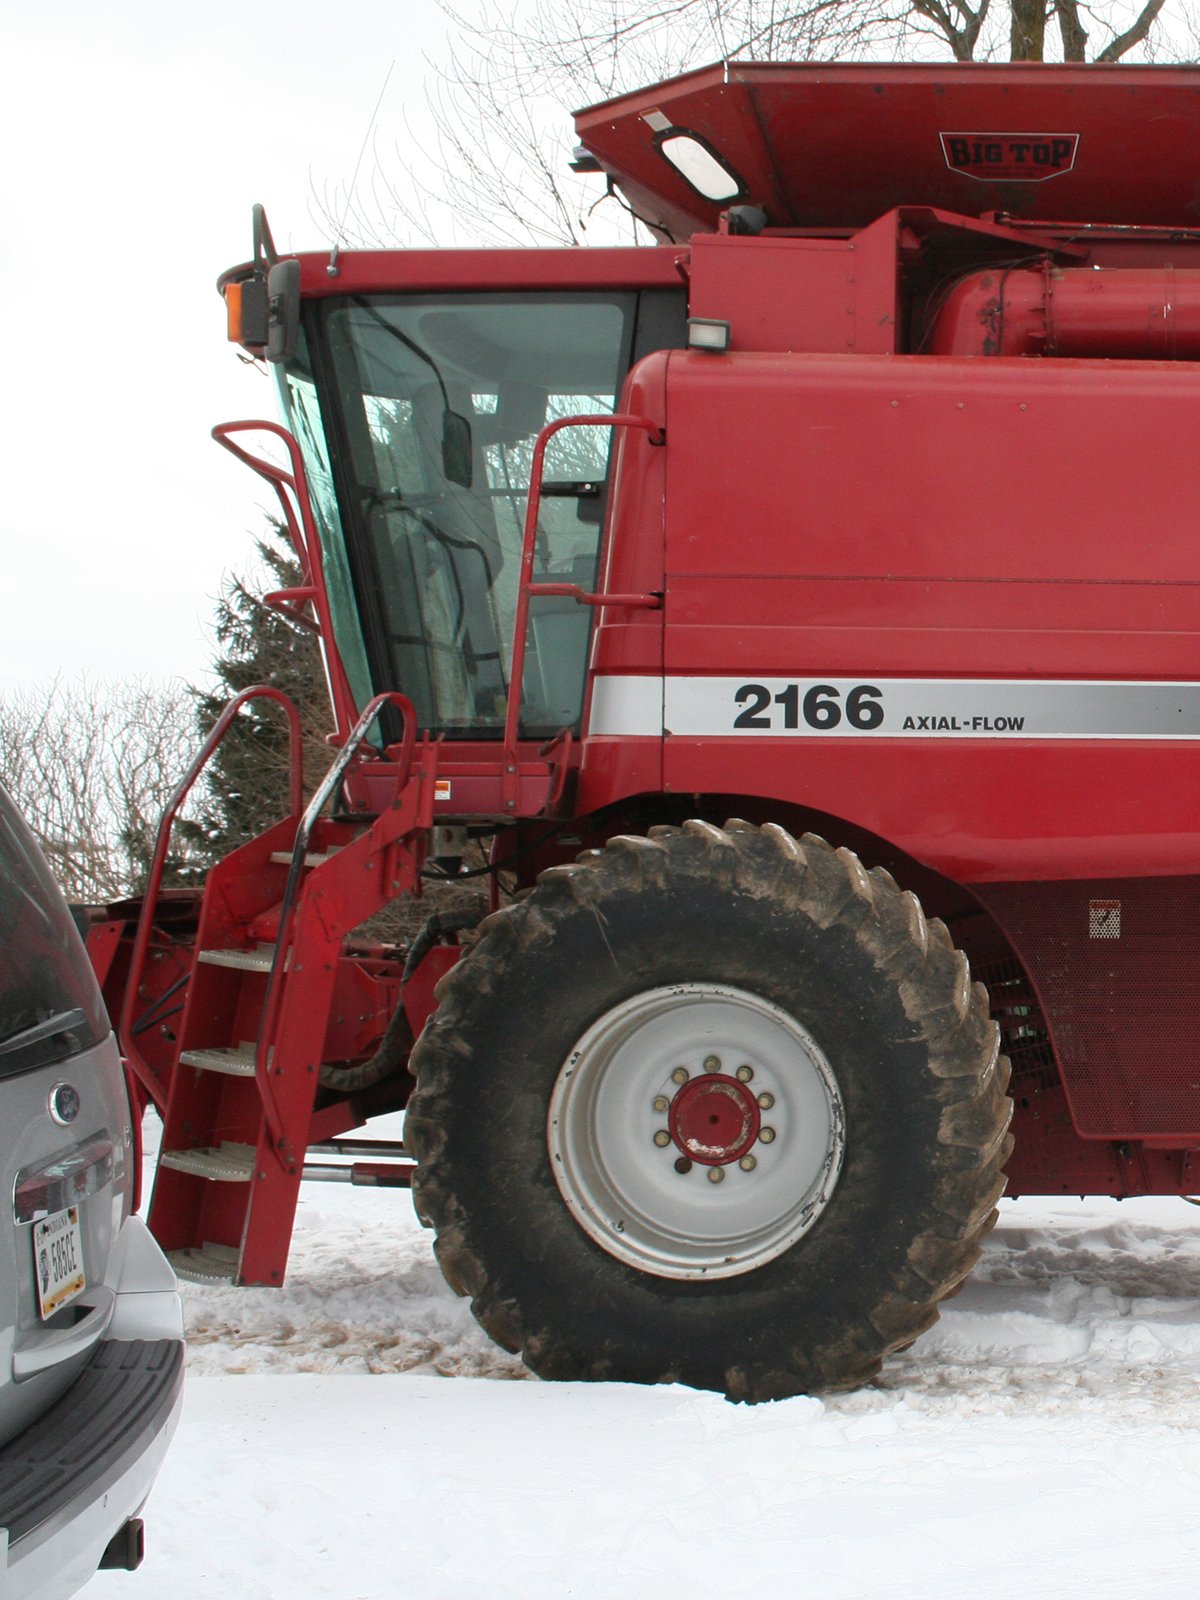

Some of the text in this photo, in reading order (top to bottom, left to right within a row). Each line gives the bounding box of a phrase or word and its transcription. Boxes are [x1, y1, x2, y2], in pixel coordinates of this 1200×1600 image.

[948, 138, 1072, 168] BIG TOP
[733, 684, 1025, 731] 2166 AXIAL-FLOW
[51, 1230, 78, 1283] 585CE
